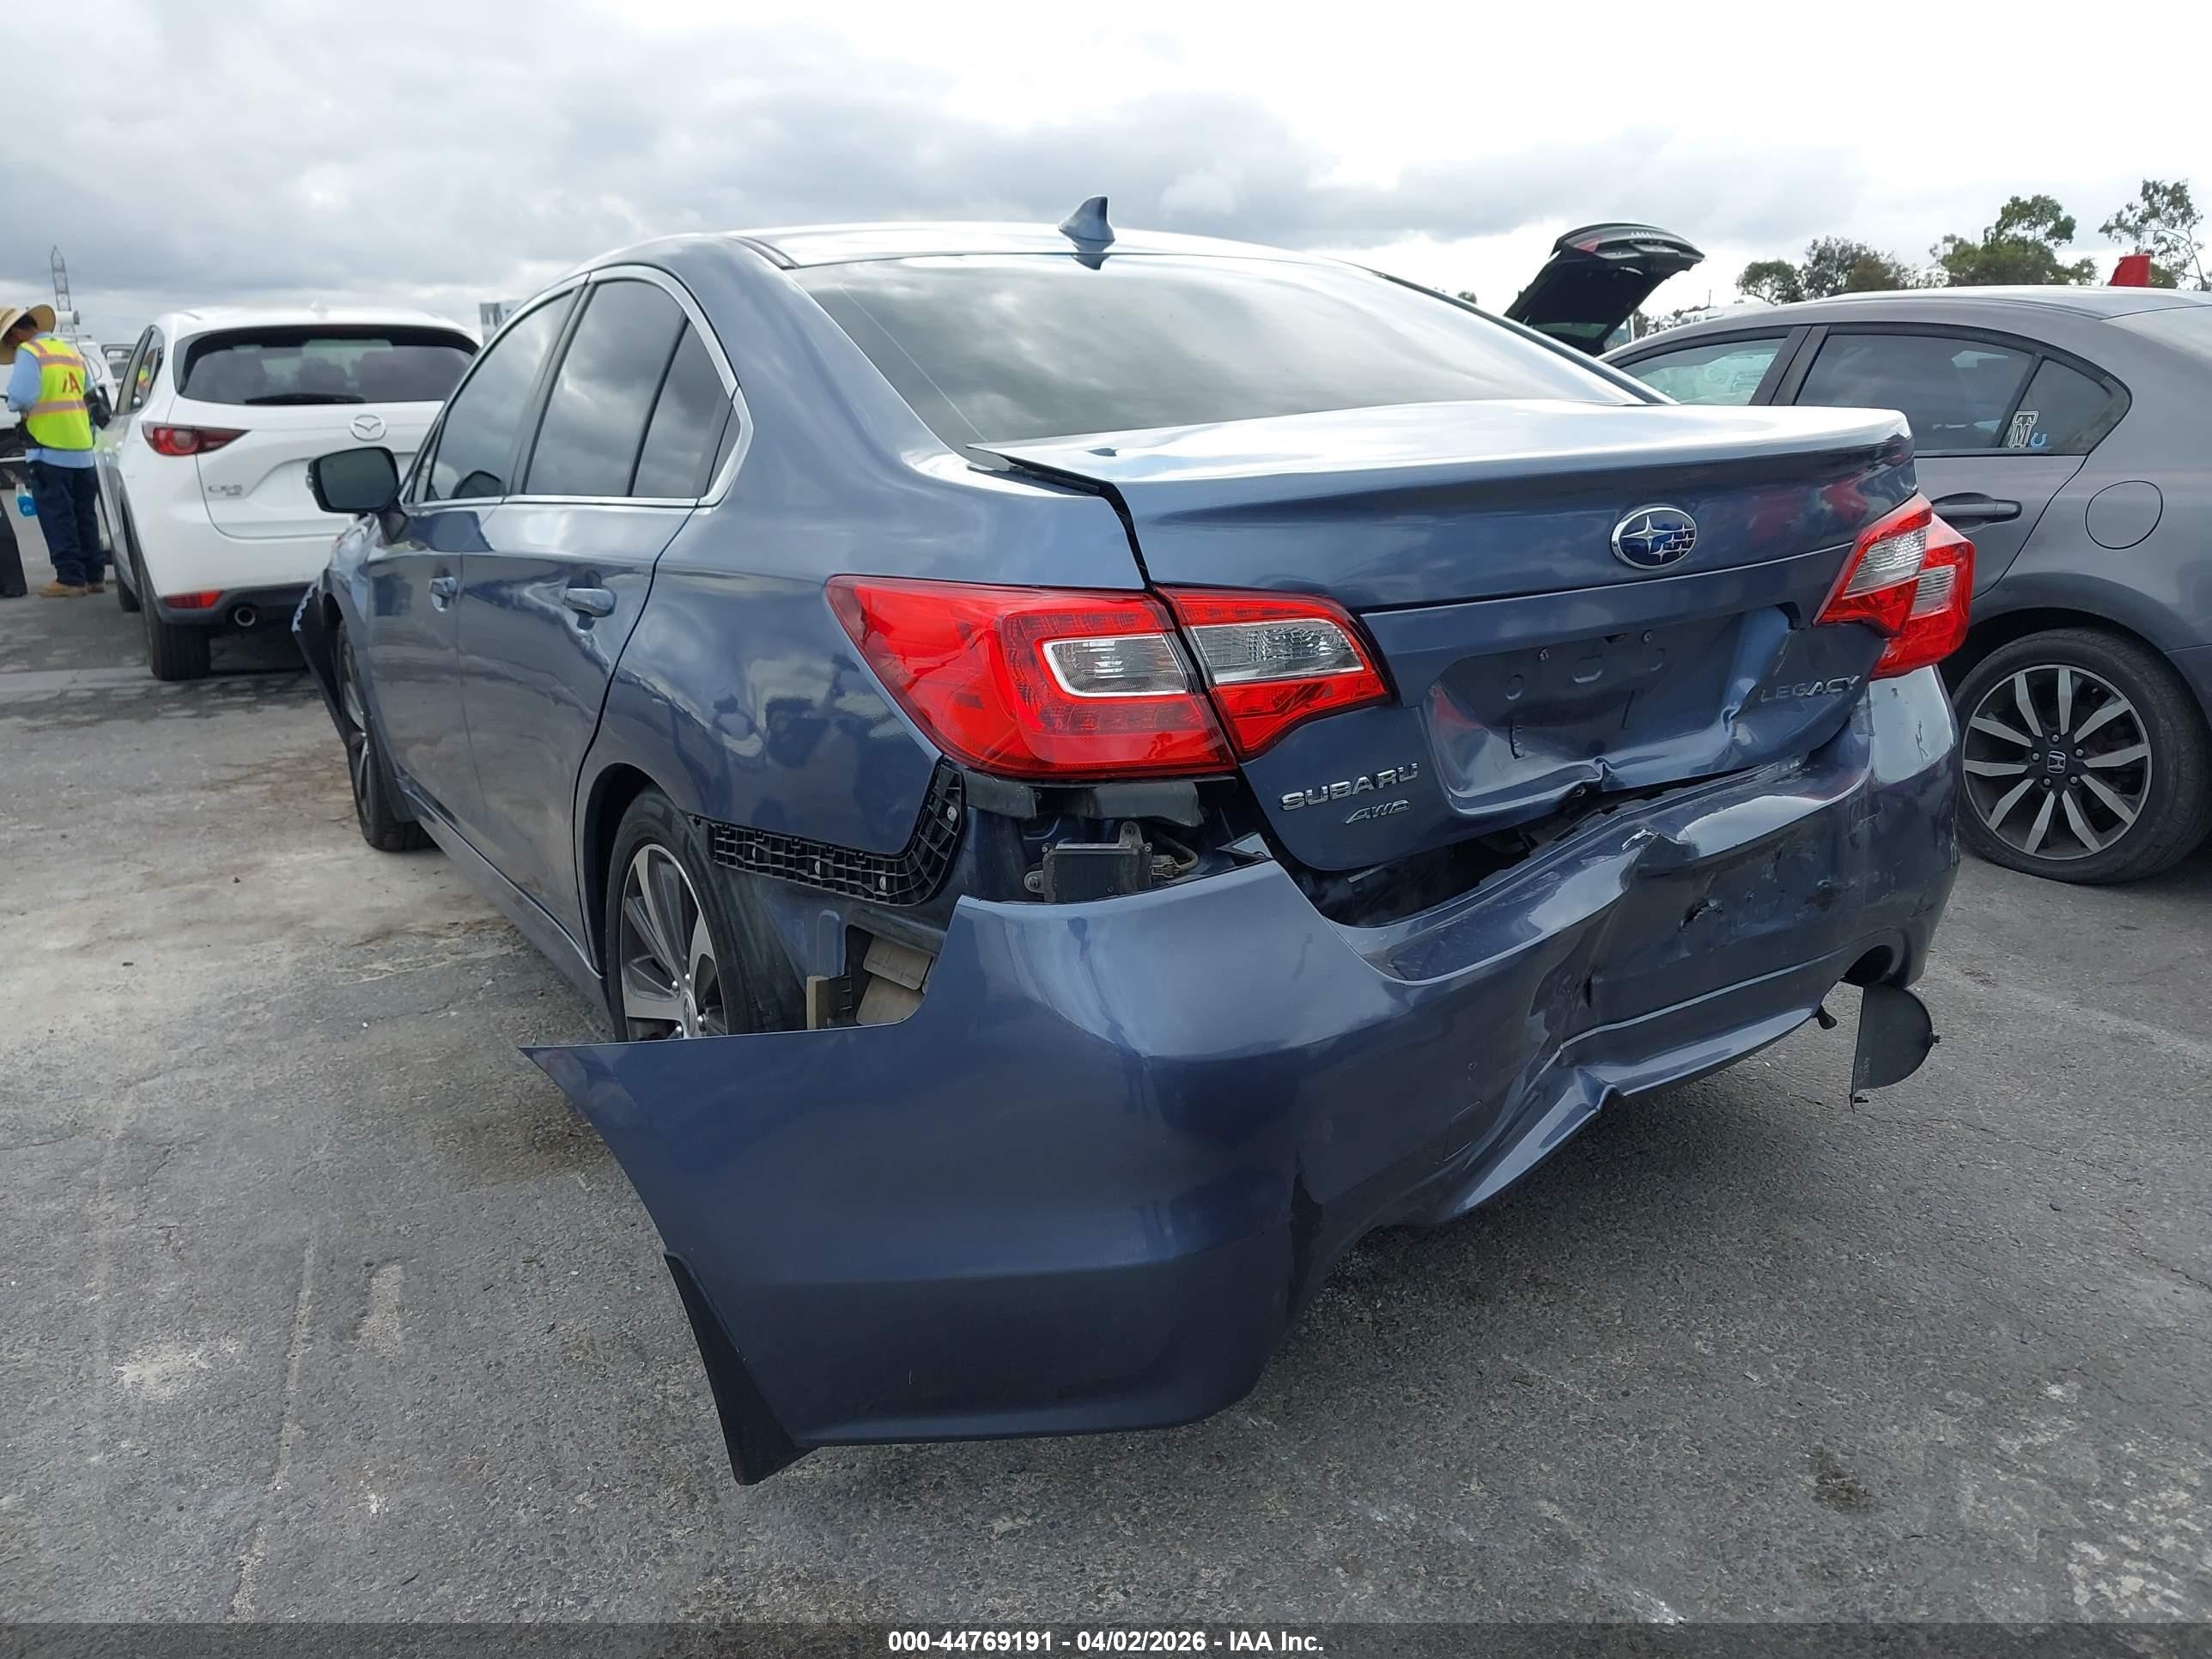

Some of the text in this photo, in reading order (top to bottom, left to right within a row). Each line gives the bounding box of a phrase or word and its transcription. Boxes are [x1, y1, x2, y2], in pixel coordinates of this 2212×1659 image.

[1760, 675, 1861, 702] LEGACY
[1280, 763, 1419, 811] SUBARU
[1344, 799, 1410, 824] AWD
